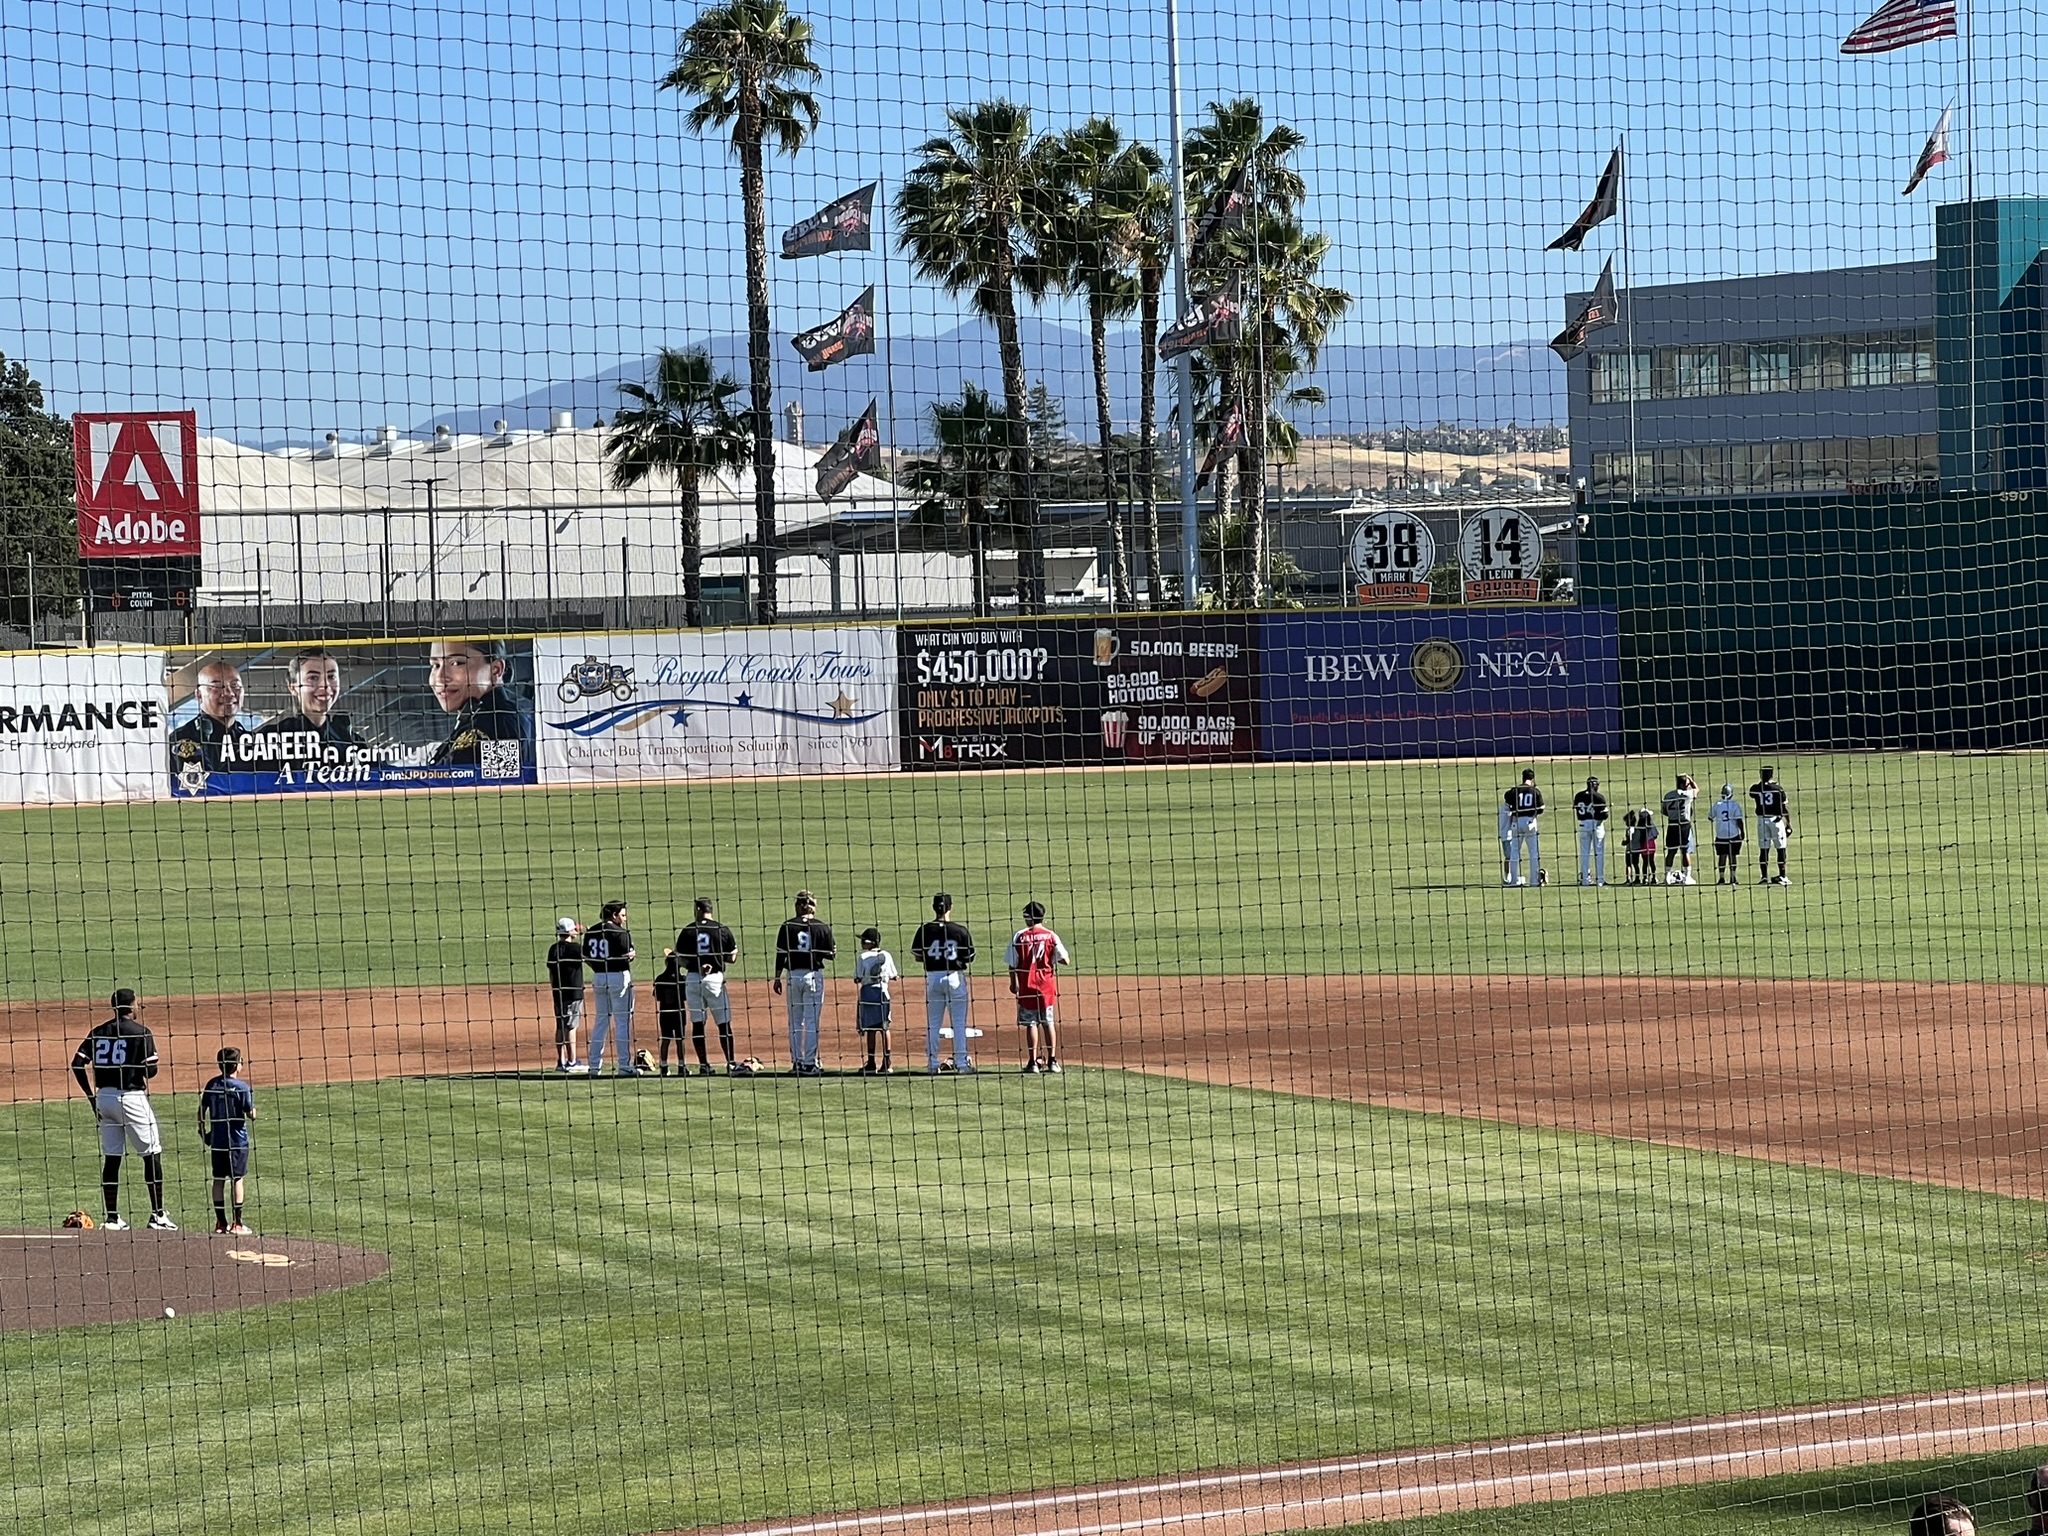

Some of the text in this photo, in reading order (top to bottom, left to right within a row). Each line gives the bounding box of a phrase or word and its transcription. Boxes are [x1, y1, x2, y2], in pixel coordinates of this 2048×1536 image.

[95, 513, 185, 545] Adobe
[1364, 523, 1418, 569] 38
[1480, 518, 1521, 565] 14
[1380, 572, 1406, 582] MARK
[130, 600, 153, 608] COUNT
[915, 630, 1023, 647] WHAT CAN YOU BUY WITH
[1130, 641, 1183, 657] 50,000
[1189, 642, 1239, 658] BEERS!
[645, 650, 874, 696] Royal Coach Tours
[917, 647, 1048, 687] $450,000?
[1304, 654, 1400, 682] IBEW
[1477, 651, 1569, 679] NECA
[1107, 671, 1159, 689] 80,000
[917, 690, 947, 708] ONLY
[950, 688, 964, 707] $1
[967, 689, 983, 706] TO
[987, 687, 1017, 706] PLAY
[1108, 685, 1179, 704] HOTDOGS!
[0, 701, 158, 733] RMANCE
[918, 705, 1067, 728] PROGRESSIVE JACKPOTS.
[1138, 716, 1236, 731] 90,000 BAGS
[45, 734, 97, 753] Ledyard
[220, 730, 321, 763] A CAREER
[568, 736, 873, 759] Charter Bus Transportation Solution since 1960
[952, 735, 1009, 743] CASINO
[1138, 731, 1234, 745] OF POPCORN!
[323, 745, 338, 763] A
[275, 760, 371, 785] A Team
[1518, 792, 1533, 807] 10
[1759, 791, 1774, 806] 13
[1721, 810, 1729, 822] 3
[588, 938, 609, 959] 39
[697, 932, 711, 953] 2
[928, 939, 958, 961] 48
[95, 1039, 128, 1066] 26
